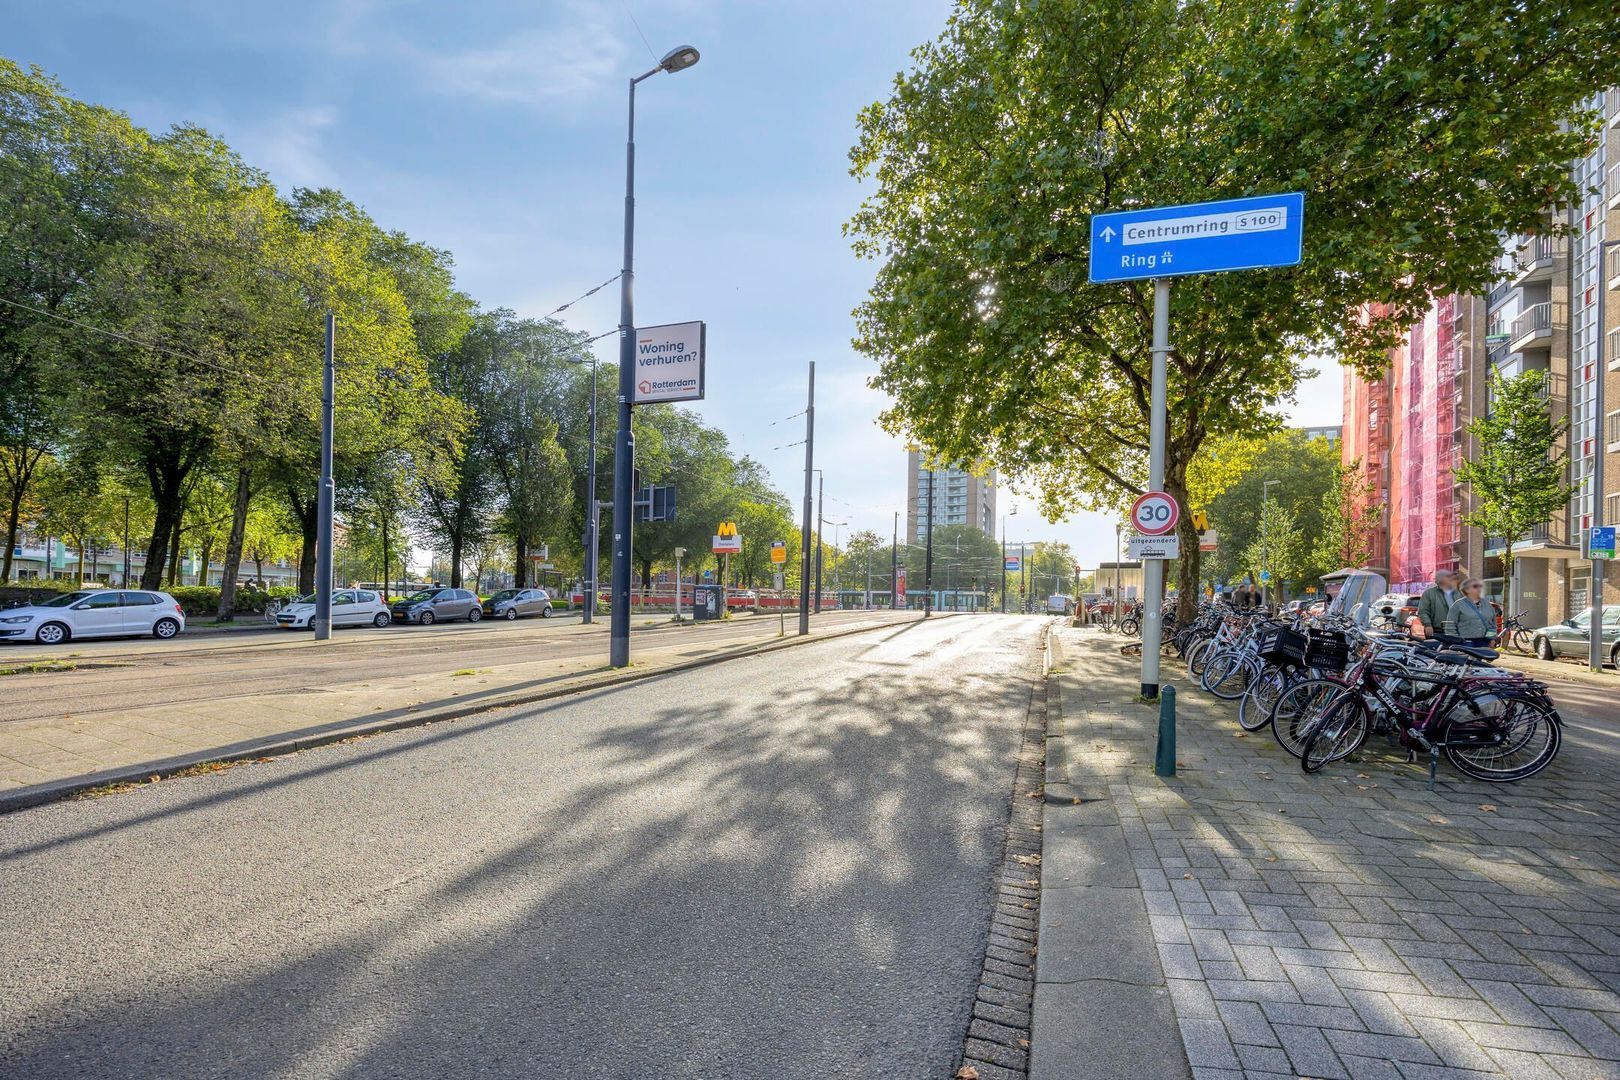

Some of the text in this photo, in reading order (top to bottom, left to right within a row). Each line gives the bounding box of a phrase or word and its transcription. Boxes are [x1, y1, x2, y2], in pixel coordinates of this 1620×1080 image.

[1128, 214, 1276, 240] Centrumring S 100
[1121, 253, 1157, 269] Ring
[639, 341, 684, 354] Woning
[639, 351, 698, 367] verhuren?
[652, 379, 696, 389] Rotterdam
[1139, 505, 1170, 522] 30
[1592, 528, 1601, 539] P
[1131, 537, 1177, 545] uitgezonderd
